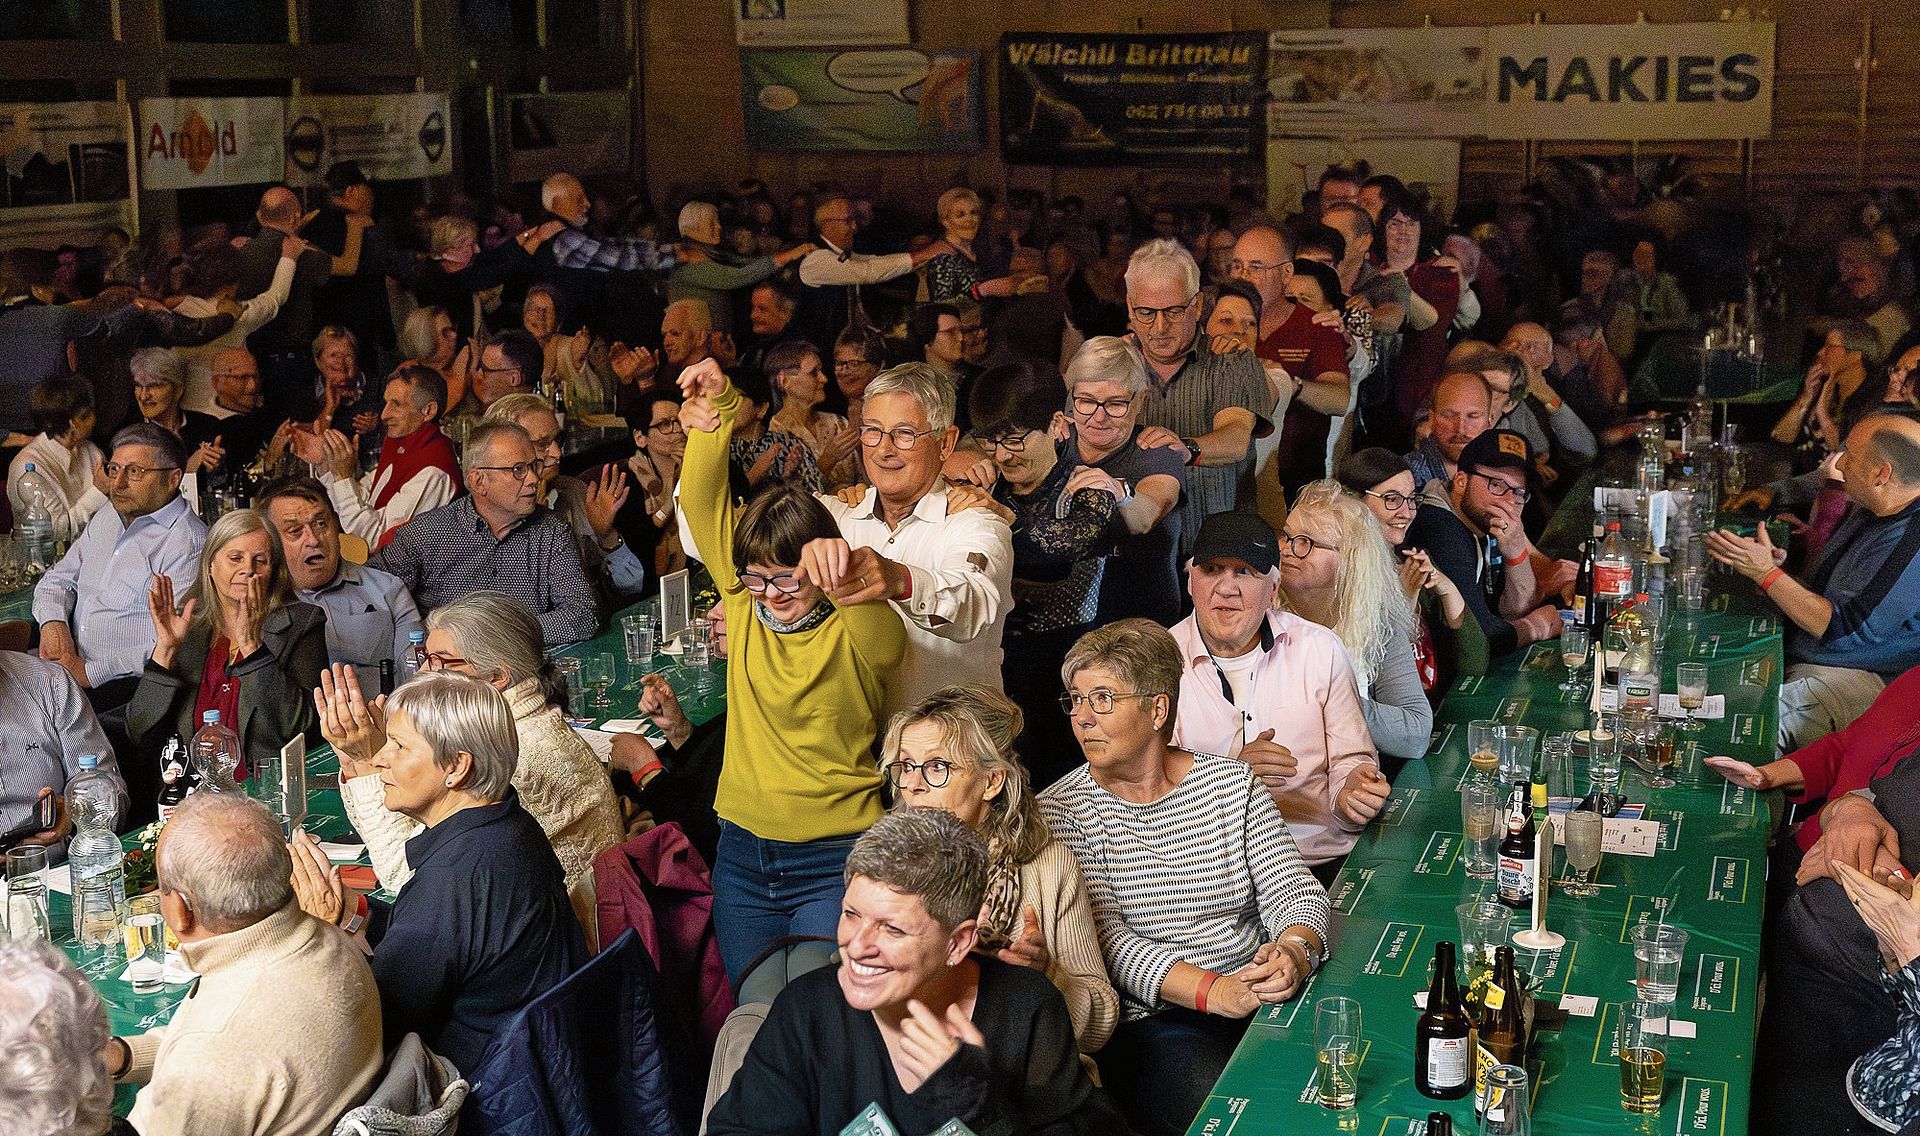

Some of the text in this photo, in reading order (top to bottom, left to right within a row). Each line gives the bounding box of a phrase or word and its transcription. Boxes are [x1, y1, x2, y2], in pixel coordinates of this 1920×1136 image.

[1499, 53, 1761, 102] MAKIES
[148, 120, 238, 160] Arnold
[1693, 1087, 1711, 1130] D'ici. Pour vous.
